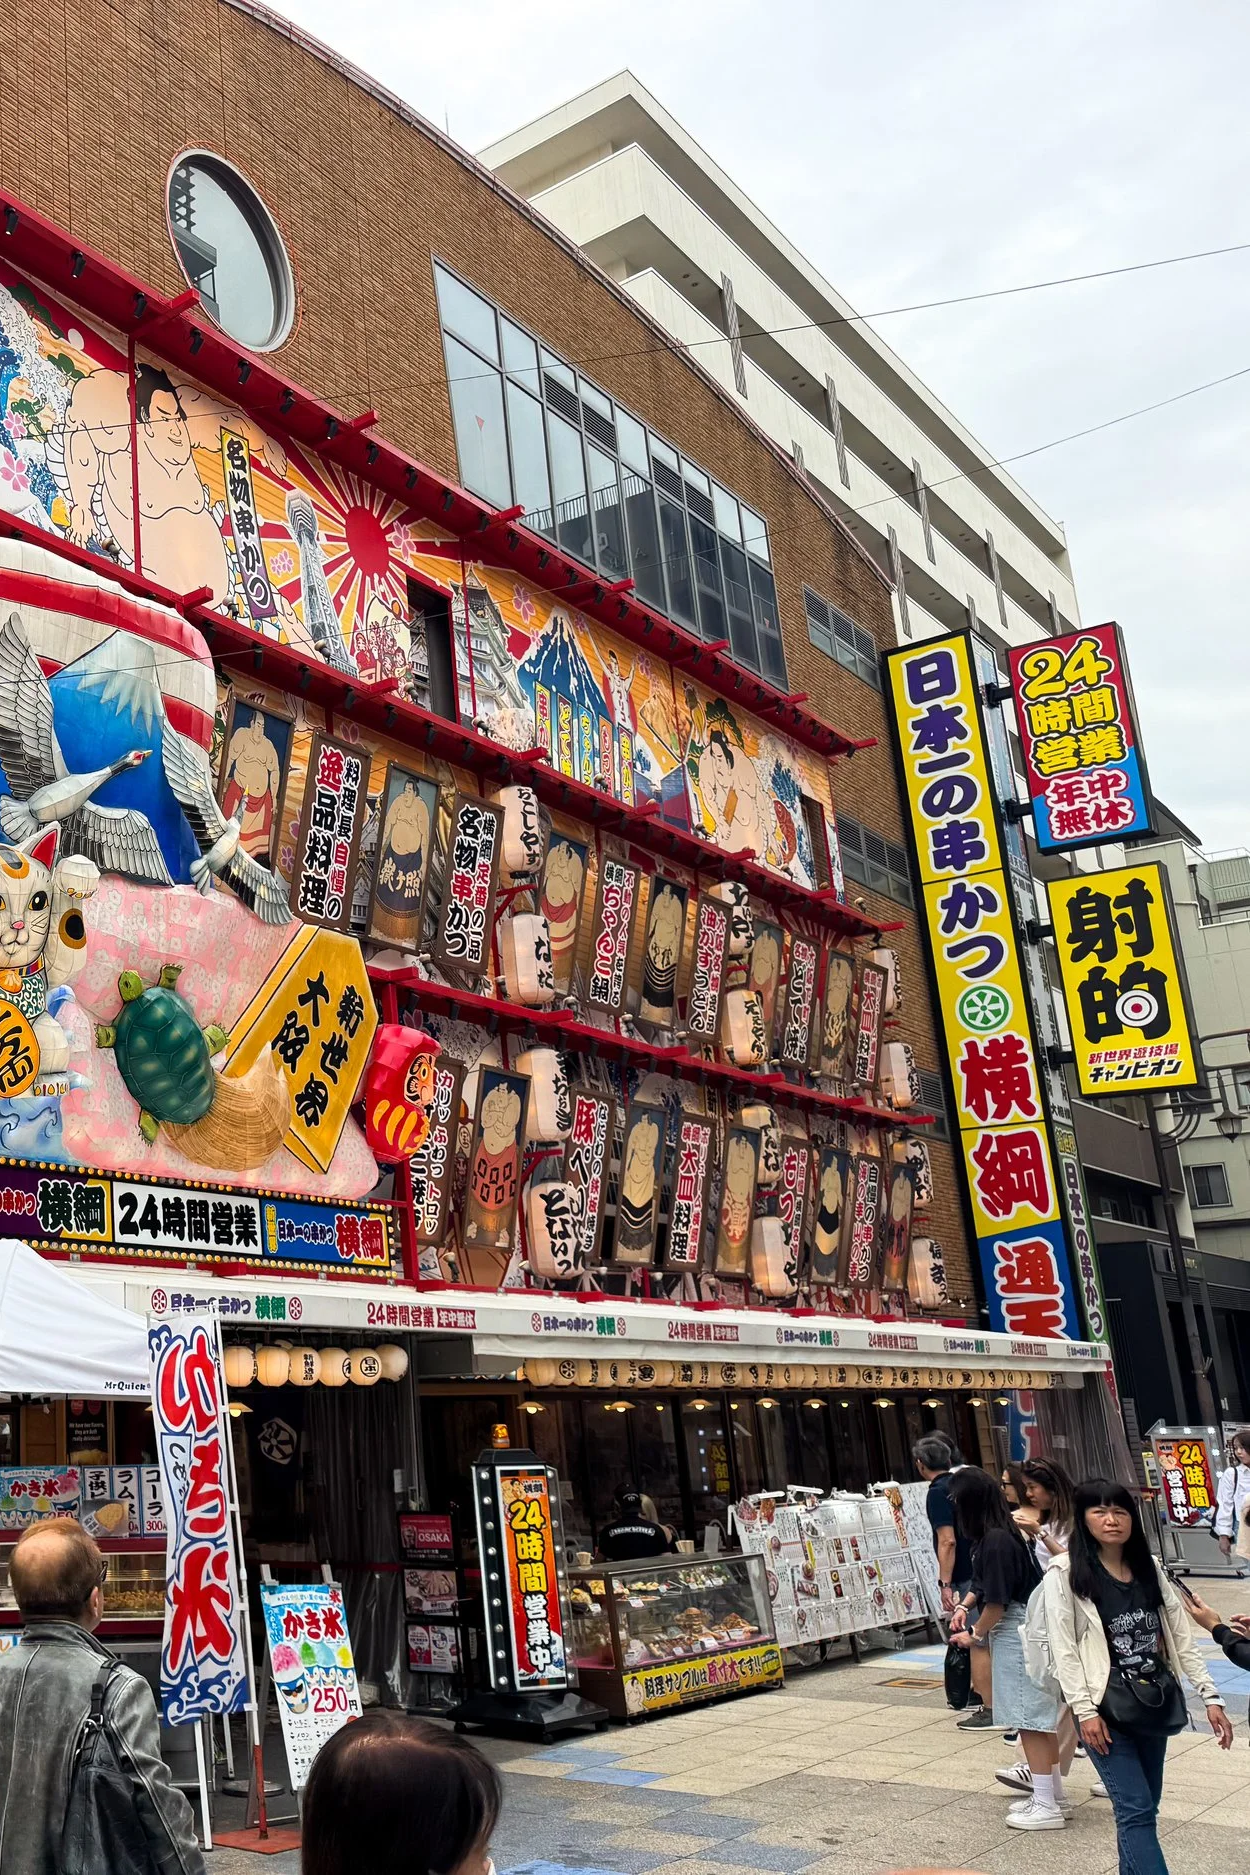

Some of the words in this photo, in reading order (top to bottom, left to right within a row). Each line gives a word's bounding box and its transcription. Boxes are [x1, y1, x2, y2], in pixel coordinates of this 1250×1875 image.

[226, 438, 271, 610] 名物串かつ
[1020, 639, 1112, 698] 24
[1027, 687, 1116, 735] 時間
[1034, 725, 1126, 775] 営業
[1047, 771, 1128, 808] 年中
[299, 746, 346, 919] 逸品料理
[327, 758, 362, 920] 料理長自慢の
[1051, 802, 1135, 840] 無休
[446, 804, 483, 957] 名物串かつ
[467, 813, 497, 962] 横綱定番の一品
[591, 883, 622, 1005] ちゃんこ鍋
[906, 650, 1006, 980] 日本一の串かつ
[960, 1034, 1049, 1218] 横綱
[689, 904, 718, 1032] 油かすうどん
[1066, 878, 1172, 1043] 射的
[1088, 1043, 1181, 1065] 新世界遊技場
[1089, 1059, 1182, 1084] チャンピオン
[36, 1179, 107, 1234] 横綱
[118, 1191, 258, 1248] 24時間営業
[277, 1217, 335, 1246] 日本一の串かつ
[335, 1214, 387, 1261] 横綱
[1063, 1159, 1103, 1338] 日本一の串かつ
[170, 1294, 251, 1316] 日本一の串かつ
[254, 1296, 287, 1321] 横綱
[367, 1302, 435, 1328] 24時間営業
[437, 1309, 477, 1329] 年中無休
[543, 1316, 594, 1333] 日本一の串かつ
[667, 1321, 712, 1341] 24時間営業
[10, 1480, 60, 1498] かき氷
[146, 1469, 163, 1516] コーラ
[1165, 1469, 1190, 1522] 営業中
[1177, 1444, 1210, 1508] 24時間
[418, 1532, 450, 1542] OSAKA
[510, 1499, 552, 1672] 24時間営業中
[283, 1608, 345, 1642] かき氷
[311, 1687, 358, 1713] 250円
